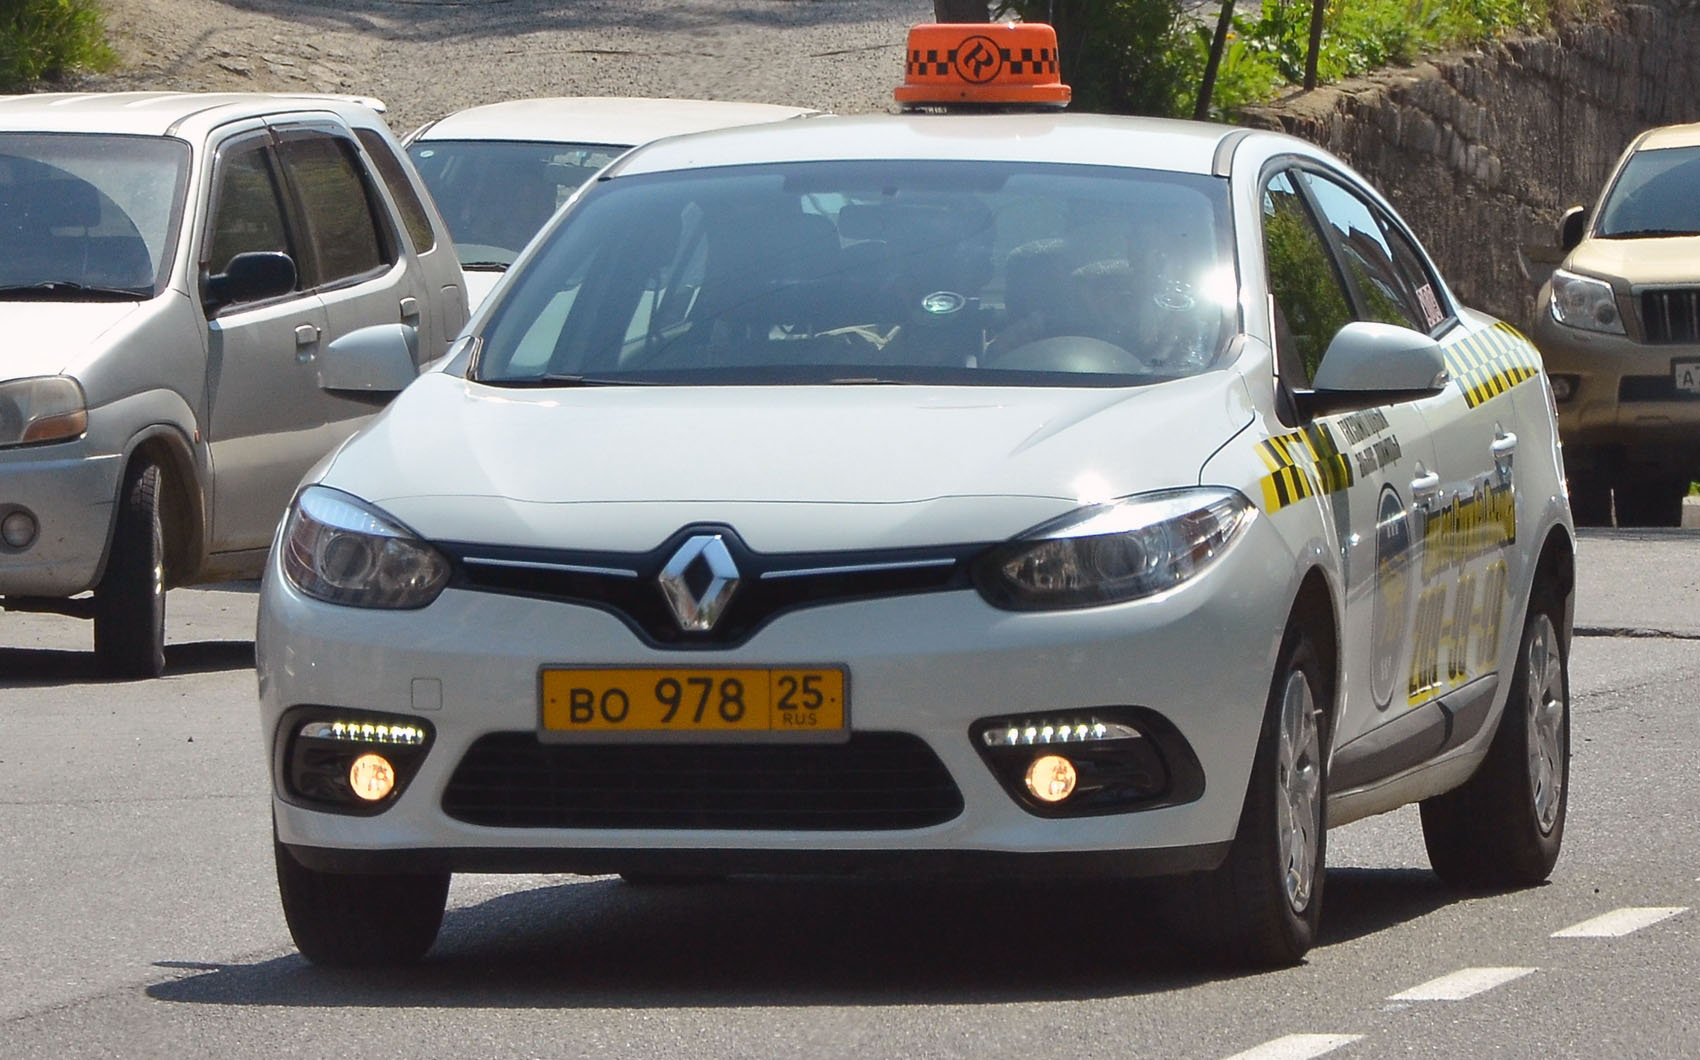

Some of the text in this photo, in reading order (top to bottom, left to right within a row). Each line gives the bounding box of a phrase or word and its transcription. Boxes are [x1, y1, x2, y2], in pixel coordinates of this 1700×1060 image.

[569, 675, 824, 724] BO 978 25
[782, 713, 818, 726] RUS
